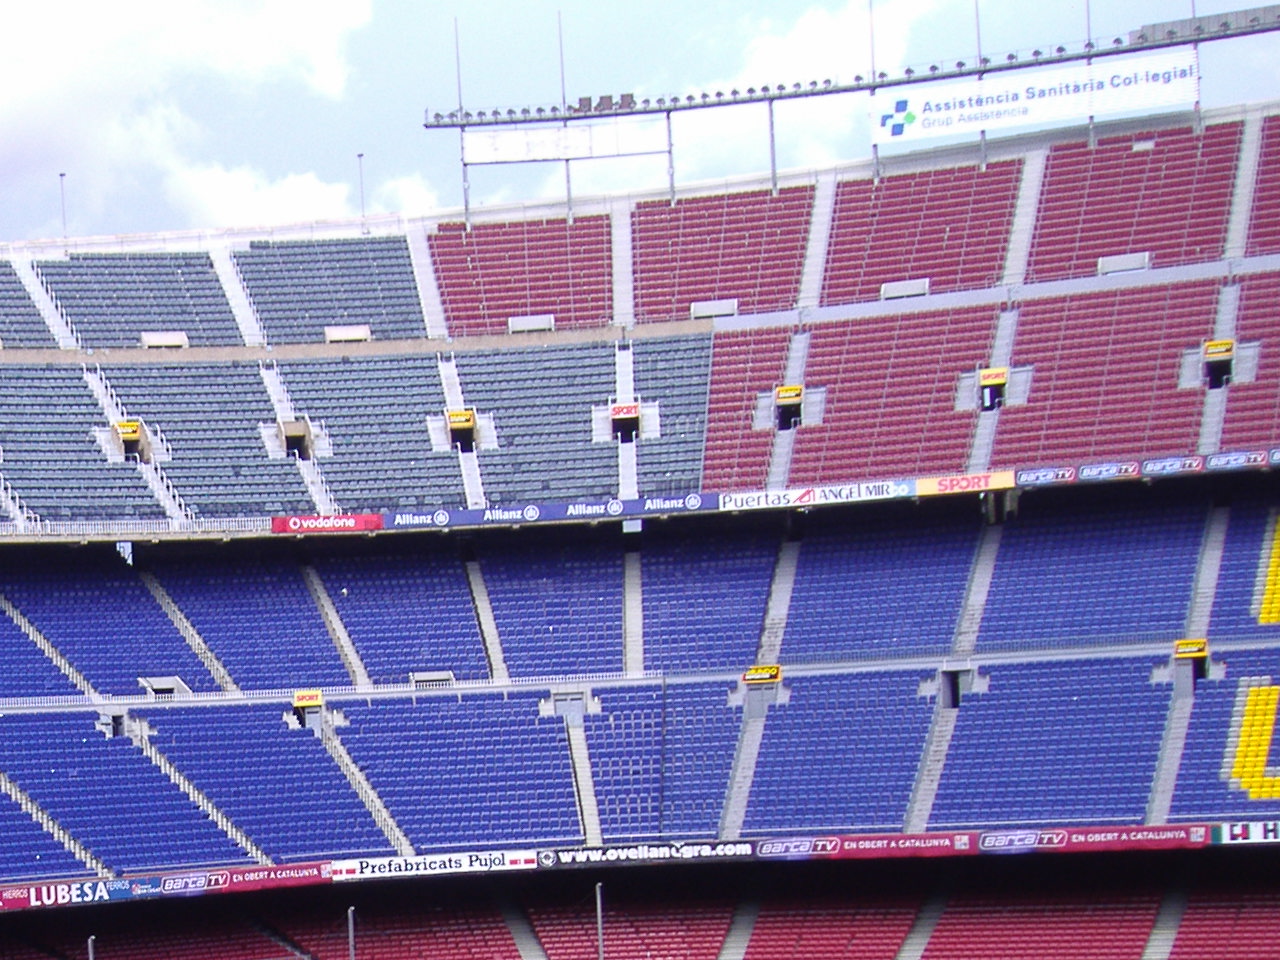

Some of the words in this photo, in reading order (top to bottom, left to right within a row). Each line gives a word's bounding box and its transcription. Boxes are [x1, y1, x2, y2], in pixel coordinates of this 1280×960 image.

[610, 404, 638, 417] SPORT
[937, 474, 992, 493] SPORT
[722, 493, 791, 509] Puertas
[865, 483, 890, 497] MIR
[566, 504, 606, 516] Allianz
[644, 498, 684, 511] Allianz
[300, 516, 356, 528] vodafone
[394, 514, 433, 526] Allianz
[483, 509, 523, 522] Allianz
[297, 694, 319, 702] SPORT
[1041, 833, 1064, 844] TV
[1071, 834, 1085, 843] EN
[1086, 833, 1119, 842] OBERT
[1120, 832, 1129, 840] A
[1130, 830, 1187, 841] CATALUNYA
[815, 840, 838, 851] TV
[843, 840, 857, 850] EN
[858, 839, 888, 849] OBERT
[889, 839, 897, 848] A
[898, 838, 951, 848] CATALUNYA
[359, 857, 463, 875] Prefabricats
[468, 852, 506, 871] Pujol
[209, 874, 228, 886] TV
[232, 874, 244, 883] EN
[244, 871, 269, 881] OBERT
[269, 870, 276, 879] A
[276, 867, 319, 879] CATALUNYA
[29, 881, 110, 907] LUBESA
[106, 879, 130, 891] FERROS
